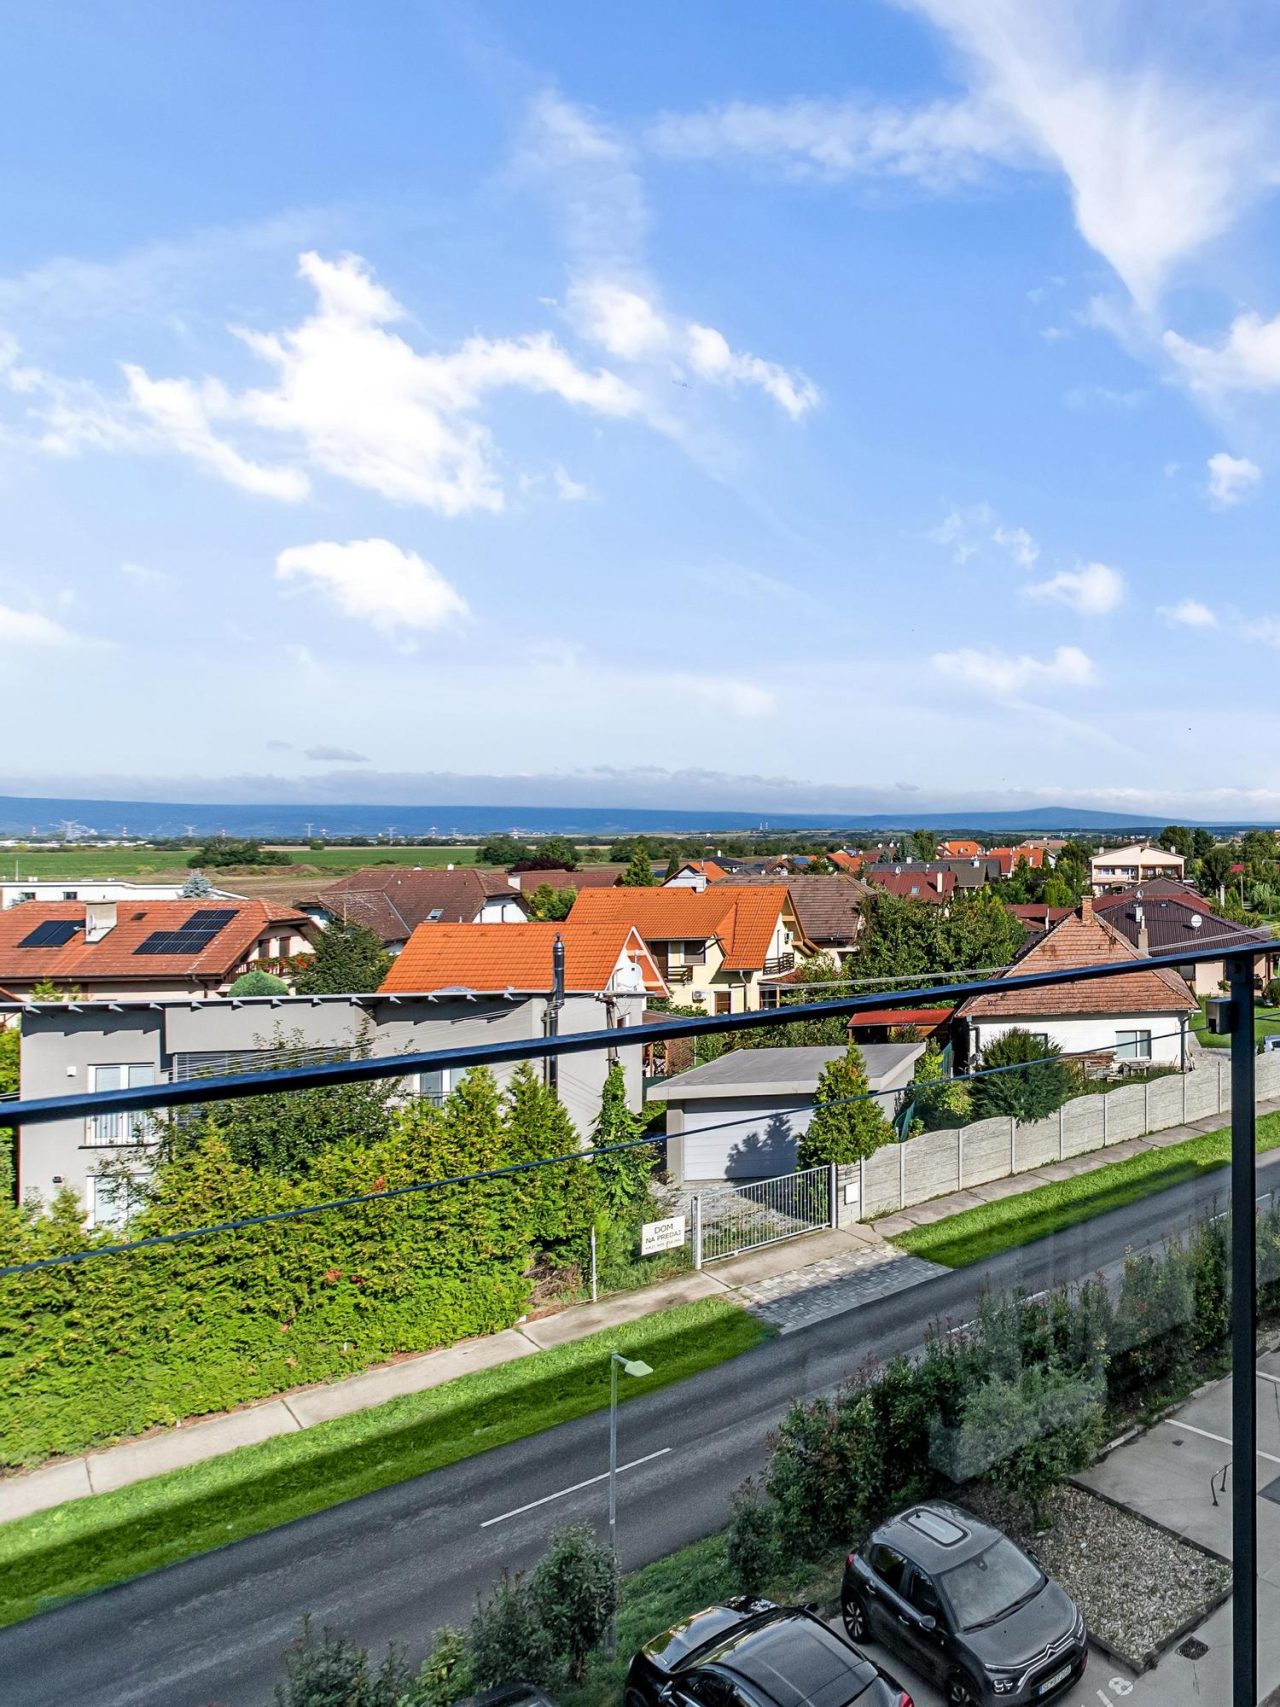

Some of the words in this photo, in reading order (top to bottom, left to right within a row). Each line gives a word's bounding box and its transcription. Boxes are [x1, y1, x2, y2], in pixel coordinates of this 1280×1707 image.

[654, 1223, 673, 1234] DOM
[645, 1236, 655, 1244] NA
[656, 1230, 681, 1241] PREDAJ
